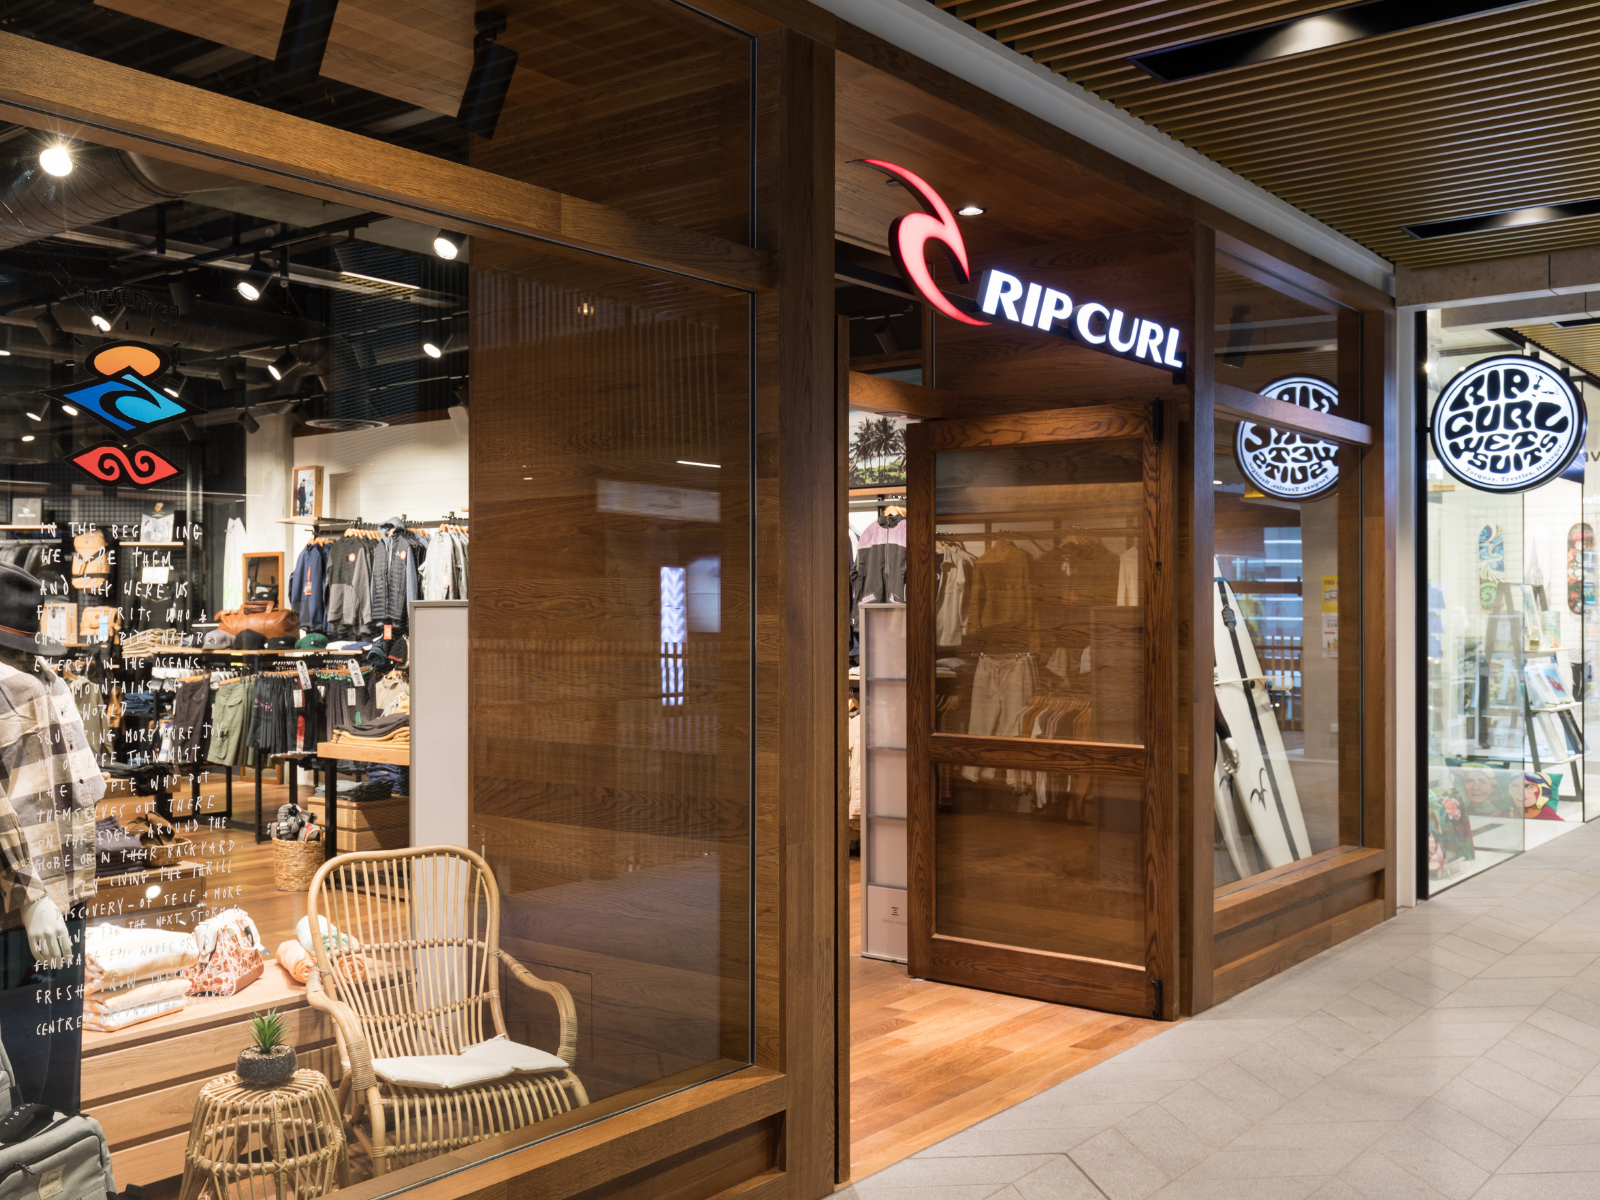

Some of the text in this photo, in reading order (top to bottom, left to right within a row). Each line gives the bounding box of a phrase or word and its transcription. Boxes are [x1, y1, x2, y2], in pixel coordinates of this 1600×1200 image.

[979, 268, 1183, 369] RIP CURL
[1449, 368, 1530, 412] RIP
[1445, 400, 1569, 441] CURL
[40, 521, 56, 538] IN
[68, 521, 97, 538] THE
[111, 520, 203, 540] BEGNING
[41, 548, 61, 565] WE
[76, 545, 117, 566] WERE
[40, 573, 189, 600] AND THEY WERE US
[36, 604, 76, 621] FREE
[89, 605, 151, 622] SPIRITS
[165, 608, 190, 623] WHO
[34, 631, 76, 646] CHASE
[86, 630, 108, 644] AND
[118, 629, 151, 646] RIDE
[33, 656, 93, 672] ENERGY
[103, 657, 113, 670] IN
[122, 653, 145, 671] THE
[74, 677, 152, 698] MOUNTAINS
[36, 705, 68, 721] THE
[125, 728, 155, 743] MORE
[202, 722, 224, 739] JOY
[88, 751, 117, 768] LIFE
[126, 749, 160, 767] THAN
[36, 770, 210, 801] THE PEPLE WHO PUT
[36, 795, 215, 823] THEMSELVES OUT THERE
[38, 834, 53, 850] ON
[64, 832, 87, 849] THE
[97, 826, 131, 845] EDGE
[208, 815, 227, 832] THE
[35, 854, 71, 871] GLOBE
[80, 853, 93, 864] OR
[101, 851, 111, 863] IN
[120, 846, 157, 863] THEIR
[33, 859, 232, 903] REALLY LIVING THE THRILL
[55, 897, 124, 921] DISCOVERY
[139, 897, 152, 908] OF
[163, 889, 196, 906] SELF
[214, 884, 243, 900] MORE
[128, 918, 147, 932] THE
[156, 912, 183, 927] NEXT
[190, 906, 226, 922] STORM
[180, 936, 195, 950] OR
[35, 983, 85, 1005] FRESH
[99, 971, 136, 992] SNOW
[157, 996, 180, 1014] THE
